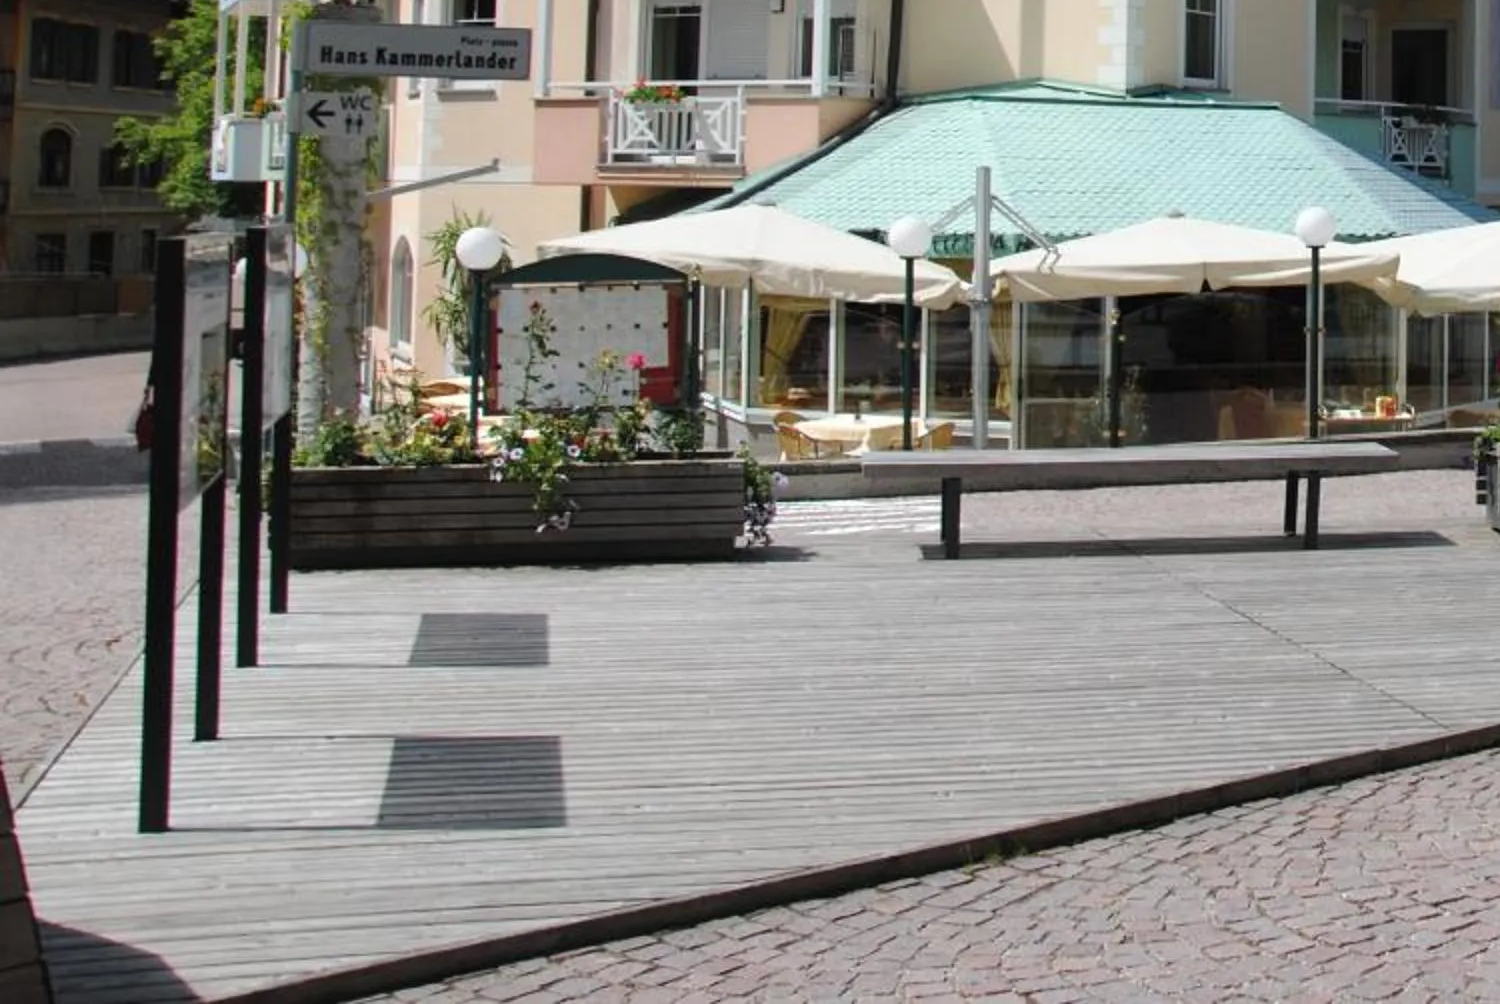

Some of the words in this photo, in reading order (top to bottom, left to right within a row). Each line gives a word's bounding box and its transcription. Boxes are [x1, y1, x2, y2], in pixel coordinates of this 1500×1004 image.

[320, 45, 368, 65] Hans
[375, 47, 517, 70] Kammerlander
[340, 94, 373, 111] WC
